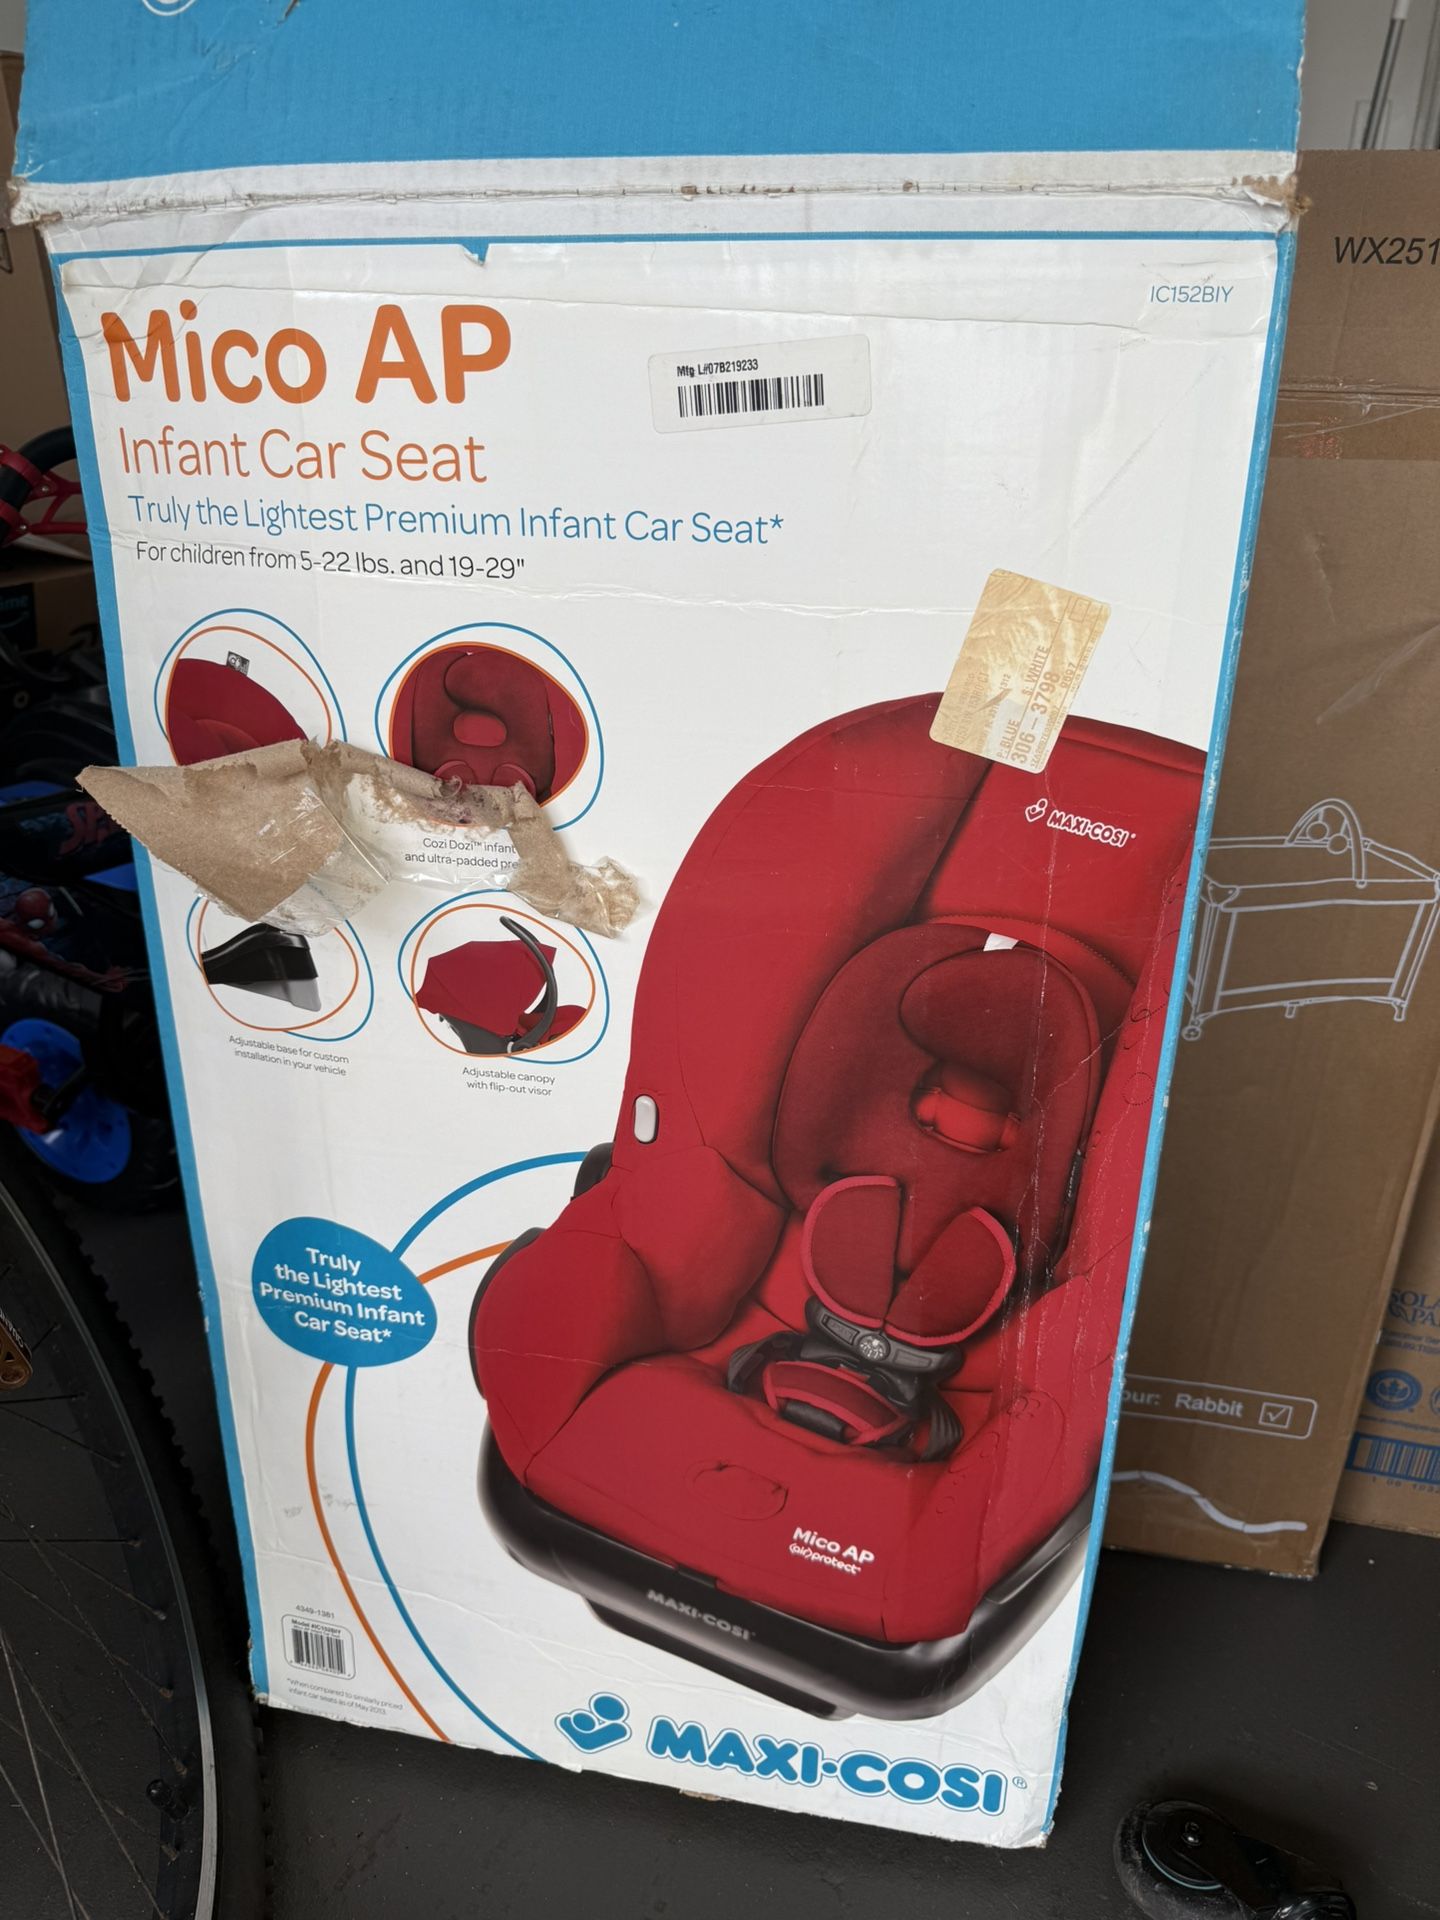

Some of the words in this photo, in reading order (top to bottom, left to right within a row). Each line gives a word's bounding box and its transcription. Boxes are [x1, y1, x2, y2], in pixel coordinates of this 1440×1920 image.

[1150, 285, 1234, 303] IC152BIY
[101, 300, 327, 404] Mico
[355, 304, 511, 404] AP
[677, 365, 695, 377] Mfg
[119, 425, 250, 478] Infant
[260, 428, 346, 479] Car
[360, 429, 487, 483] Seat
[128, 495, 191, 531] Truly
[196, 500, 238, 527] the
[243, 500, 358, 536] Lightest
[366, 503, 511, 537] Premium
[520, 507, 617, 540] Infant
[625, 510, 683, 541] Car
[136, 541, 167, 562] For
[170, 544, 245, 569] children
[249, 547, 296, 570] from
[300, 551, 350, 573] 5-22
[356, 552, 395, 575] lbs.
[400, 553, 444, 577] and
[449, 556, 525, 579] 19-29"
[1000, 718, 1020, 749] BLUE
[1029, 644, 1050, 684] WHITE
[1011, 731, 1036, 765] 306
[1030, 670, 1061, 716] 3798
[422, 837, 447, 849] Cozi
[404, 853, 426, 863] and
[427, 854, 499, 869] ultra-padded
[500, 859, 520, 870] pre
[228, 1035, 276, 1051] Adjustable
[276, 1043, 298, 1056] base
[299, 1048, 313, 1058] for
[313, 1052, 350, 1064] custom
[234, 1048, 282, 1065] installation
[283, 1057, 292, 1066] in
[292, 1060, 312, 1070] your
[313, 1064, 347, 1077] vehicle
[462, 1067, 516, 1080] Adjustable
[517, 1073, 555, 1085] canopy
[466, 1080, 488, 1090] with
[489, 1081, 527, 1094] flip-out
[528, 1086, 553, 1096] visor
[305, 1247, 361, 1276] Truly
[274, 1263, 310, 1285] the
[313, 1271, 403, 1301] Lightest
[259, 1282, 353, 1316] Premium
[357, 1302, 426, 1327] Infant
[294, 1311, 331, 1332] Car
[1120, 1389, 1161, 1406] our:
[1174, 1393, 1244, 1417] Rabbit
[793, 1527, 841, 1554] Mico
[842, 1545, 876, 1565] AP
